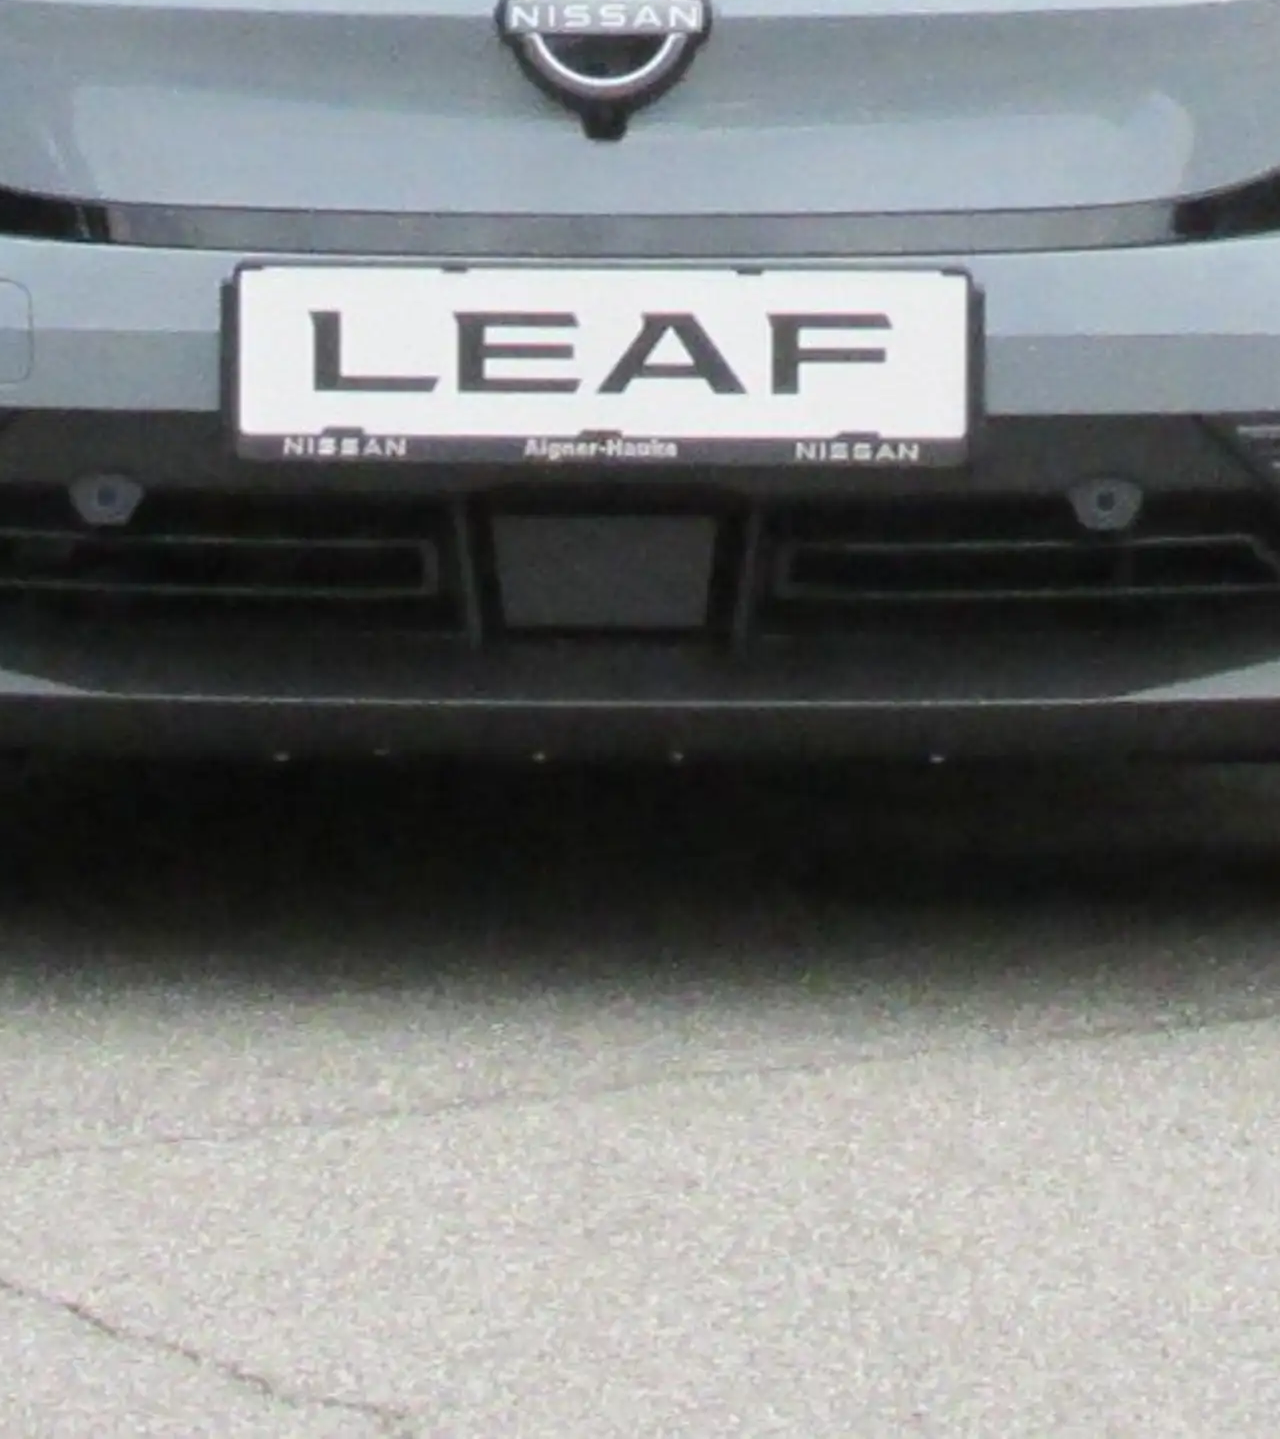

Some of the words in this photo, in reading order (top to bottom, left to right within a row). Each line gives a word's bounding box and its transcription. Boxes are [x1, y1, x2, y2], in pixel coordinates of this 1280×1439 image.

[510, 3, 700, 29] NISSAN
[309, 310, 894, 395] LEAF
[282, 436, 408, 457] NISSAN
[794, 441, 920, 461] NISSAN
